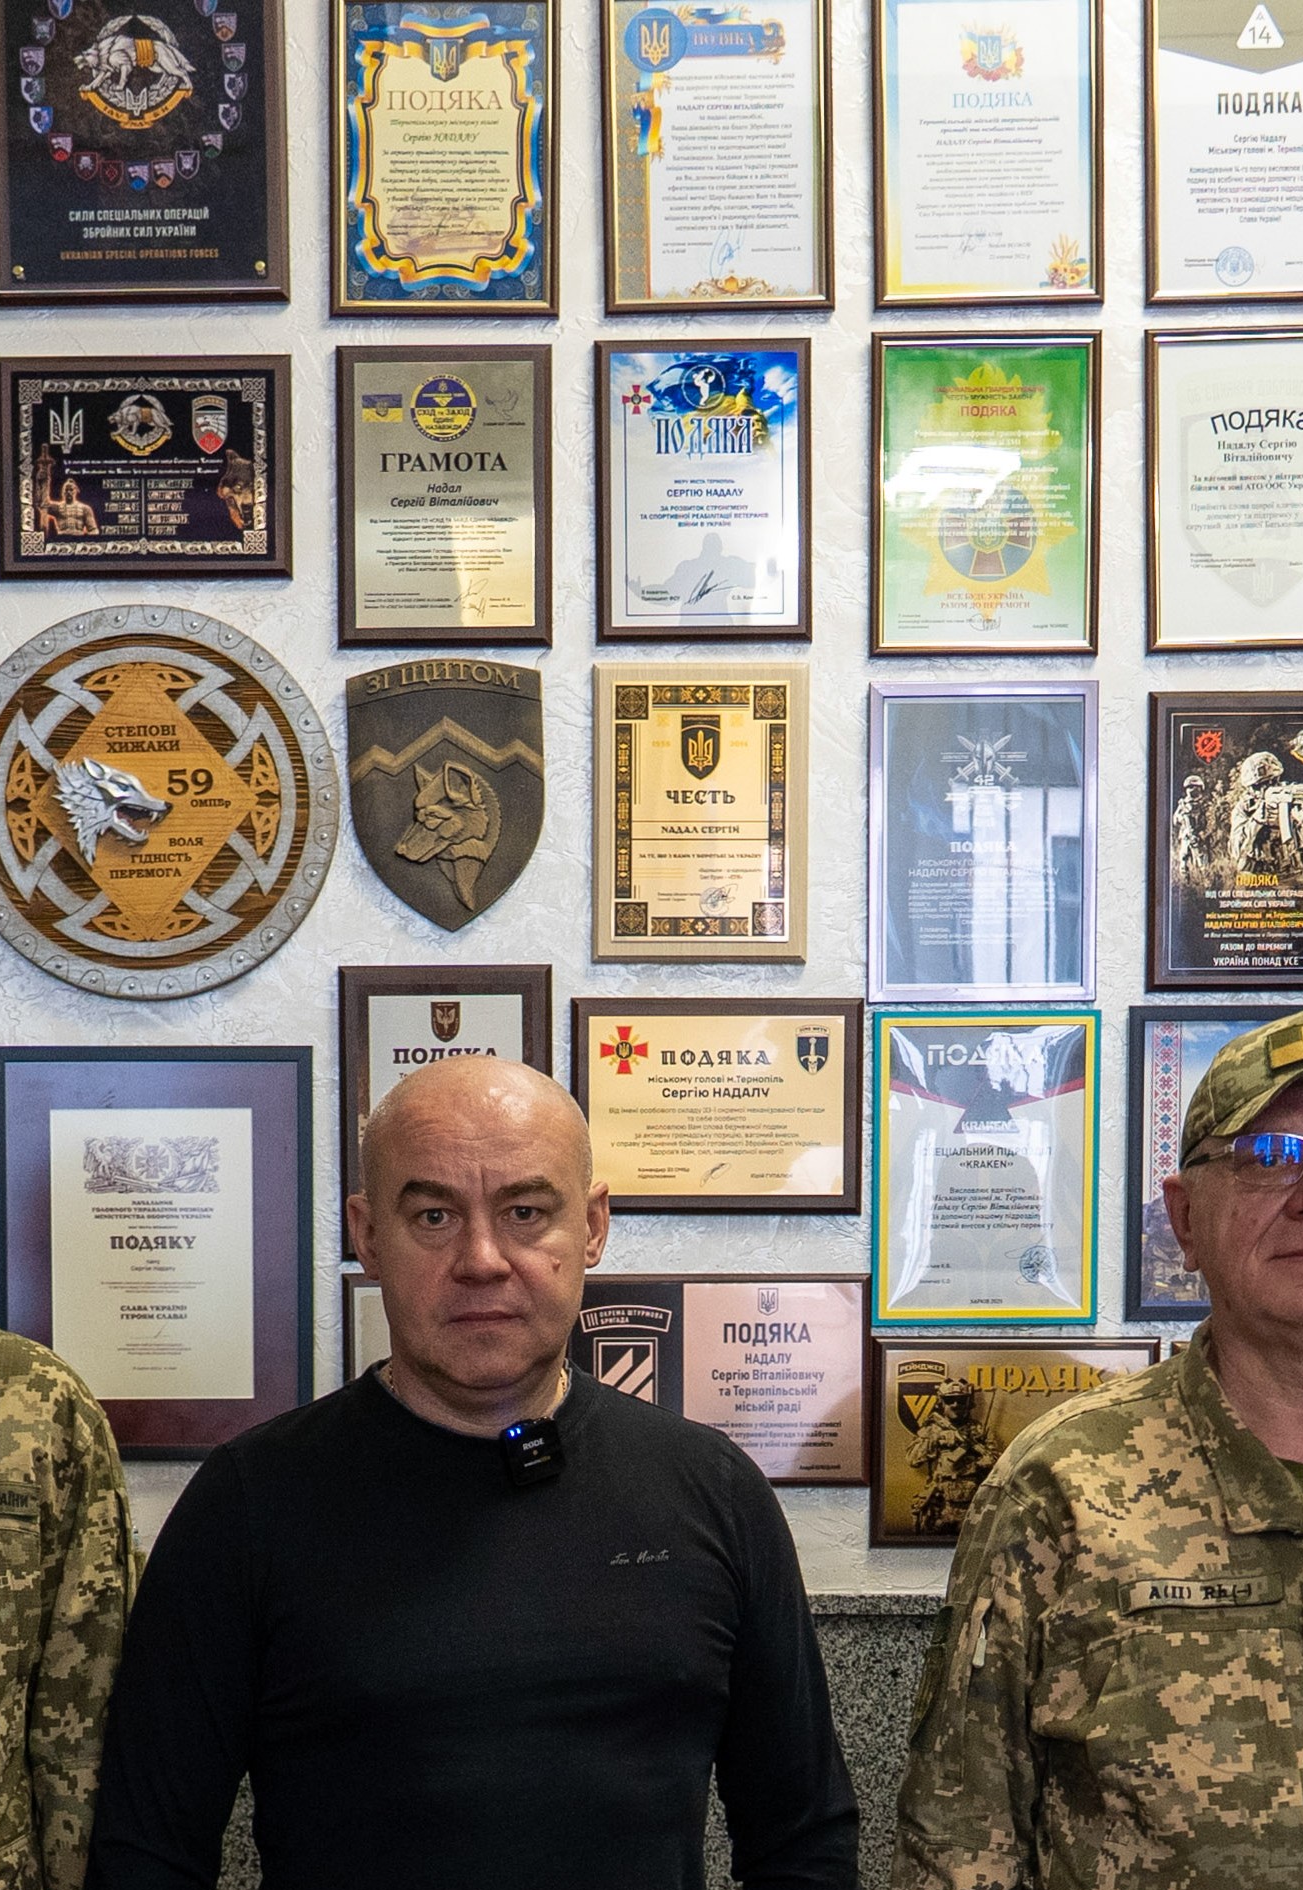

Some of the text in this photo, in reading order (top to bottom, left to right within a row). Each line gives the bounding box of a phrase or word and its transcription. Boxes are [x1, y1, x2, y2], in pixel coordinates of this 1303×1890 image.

[1249, 26, 1272, 45] 14
[387, 89, 503, 114] ПОДЯКА
[952, 91, 1033, 110] ПОДЯКА
[1217, 91, 1303, 117] ПОДЯКА
[69, 207, 209, 223] СИЛИ СПЕЦІАЛЬНИХ ОПЕРАЦІЙ
[960, 404, 1017, 418] ПОДЯКА
[655, 417, 753, 459] ПОДЯКА
[1218, 439, 1297, 451] Надалу Сергію
[380, 452, 508, 474] ГРАМОТА
[1223, 452, 1294, 464] Віталійовичу
[427, 482, 462, 493] Надал
[390, 495, 499, 510] Сергій Віталійович
[366, 663, 521, 694] ЗІ ЩИТОМ
[104, 725, 177, 739] СТЕПОВІ
[105, 739, 181, 754] ХИЖАКИ
[167, 769, 214, 797] 59
[973, 774, 995, 786] 42
[666, 790, 736, 806] ЧЕСТЬ
[168, 836, 204, 848] ВОЛЯ
[131, 852, 192, 865] ГІДНІСТЬ
[109, 867, 182, 880] ПЕРЕМОГА
[1235, 874, 1279, 887] ПОДЯКА
[1213, 956, 1299, 967] УКРАЇНА ПОНАД УСЕ
[660, 1049, 772, 1067] ПОДЯКА
[662, 1087, 769, 1101] Сергію НАДАЛУ
[962, 1120, 1010, 1131] KRAKEN
[110, 1235, 197, 1252] ПОДЯКУ
[722, 1323, 812, 1346] ПОДЯКА
[745, 1353, 792, 1364] НАДАЛУ
[711, 1368, 824, 1384] Сергію Віталійовичу
[719, 1384, 818, 1398] та Тернопільській
[735, 1401, 801, 1414] міській раді
[1149, 1585, 1192, 1600] A(II)
[1202, 1585, 1227, 1600] Rh
